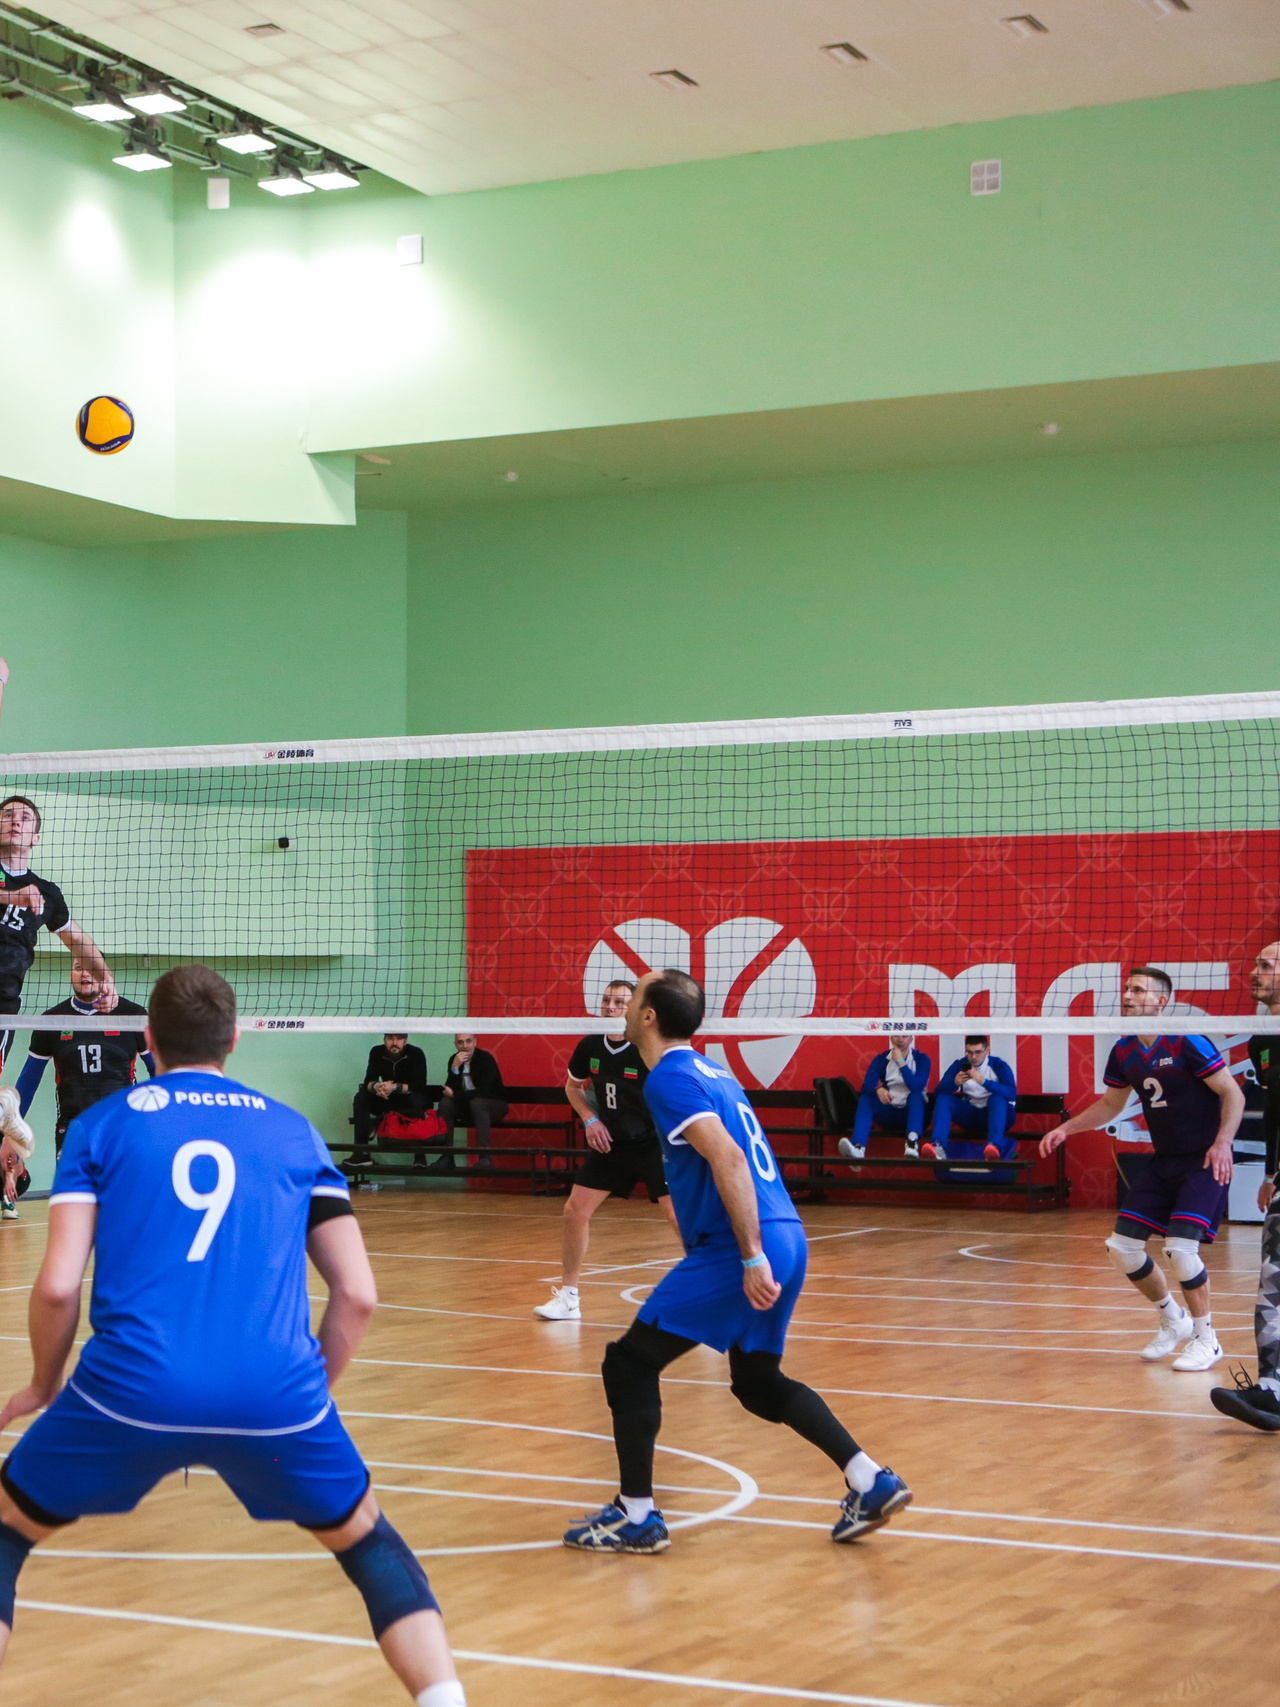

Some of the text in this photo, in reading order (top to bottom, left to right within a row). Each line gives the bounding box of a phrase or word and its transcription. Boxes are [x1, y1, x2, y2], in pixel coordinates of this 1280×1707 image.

[0, 904, 28, 931] 15
[77, 1044, 102, 1074] 13
[174, 1091, 268, 1111] РОССЕТИ
[605, 1083, 617, 1110] 8
[1143, 1077, 1168, 1108] 2
[736, 1101, 777, 1182] 8
[171, 1139, 237, 1263] 9
